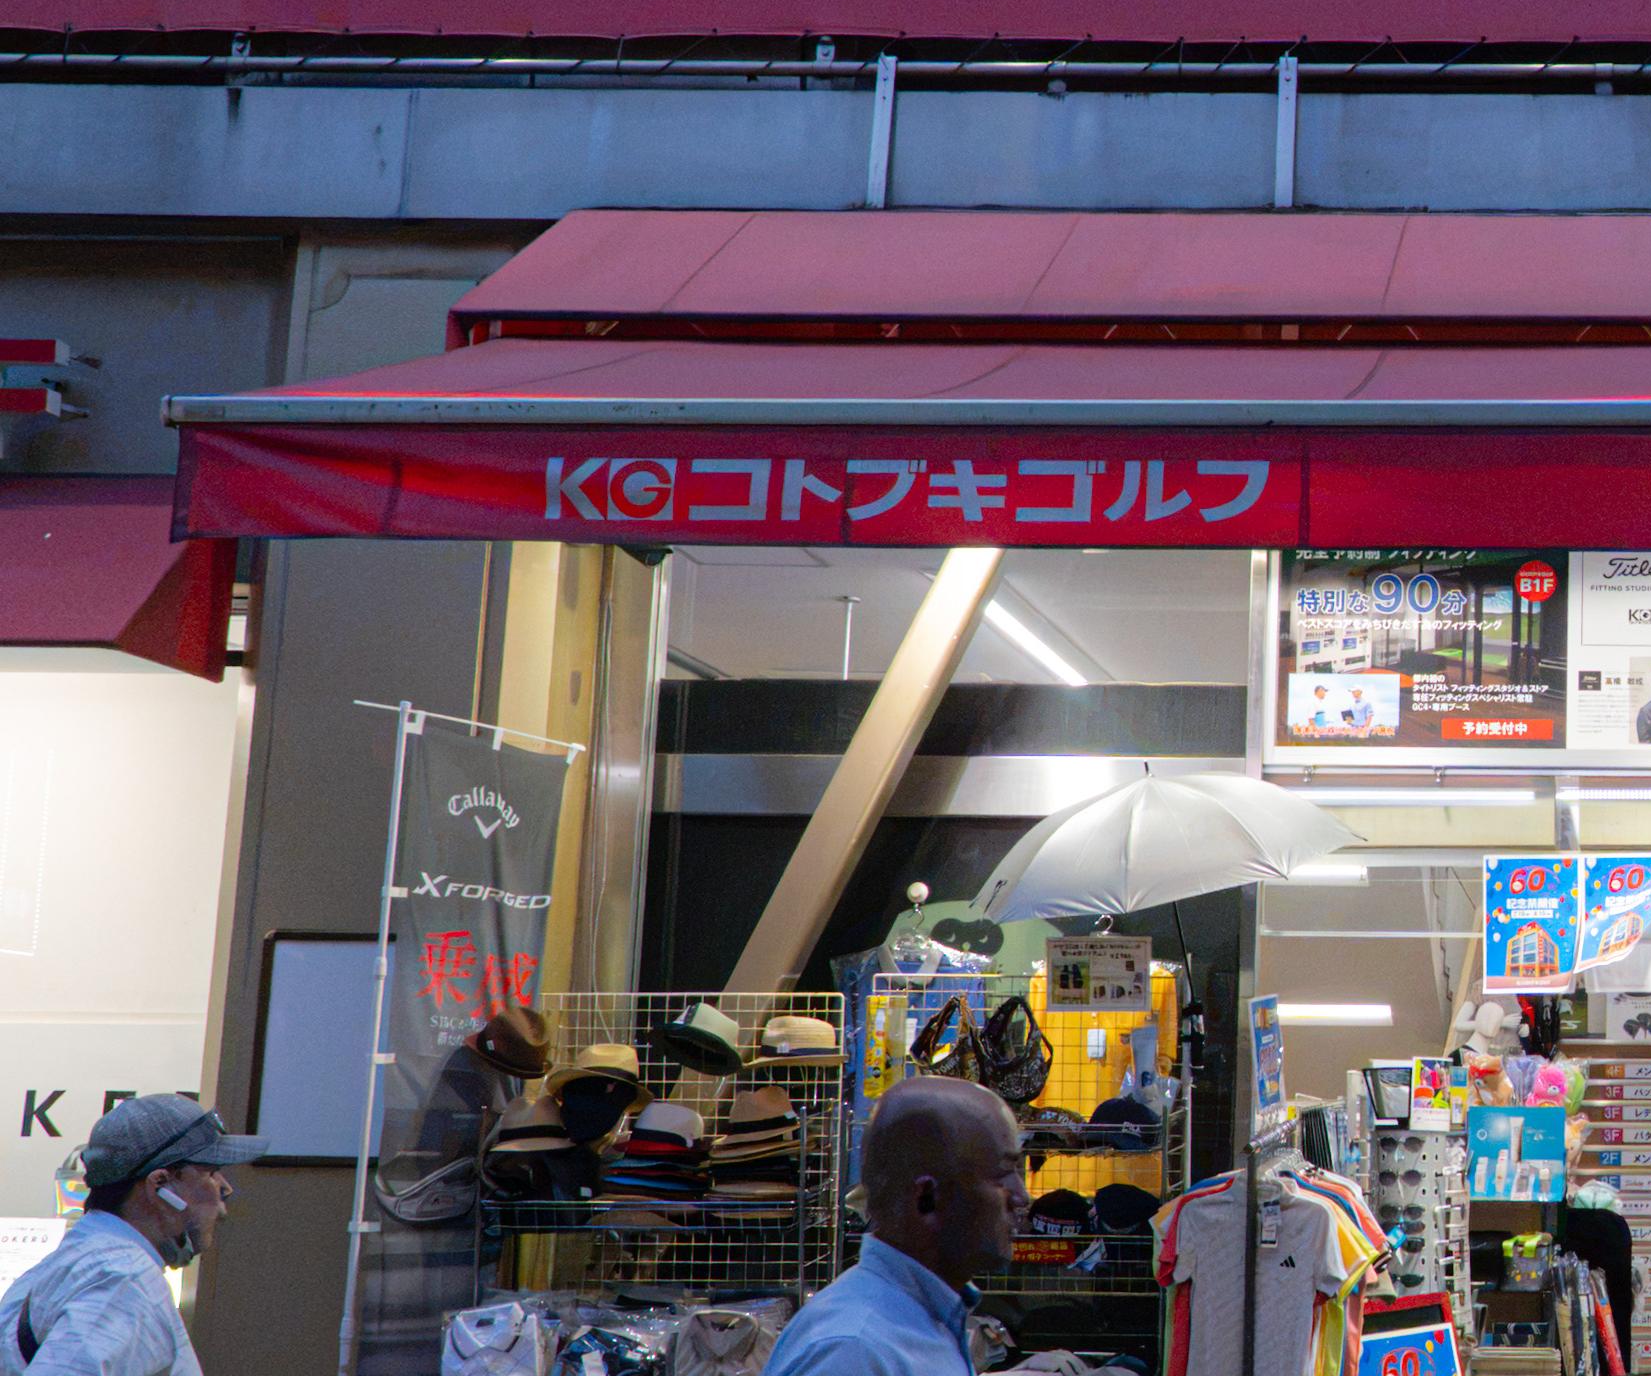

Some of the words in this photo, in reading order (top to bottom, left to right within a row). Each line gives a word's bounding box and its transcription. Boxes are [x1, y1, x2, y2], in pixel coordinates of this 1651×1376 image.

[545, 457, 1270, 522] KGコトブキゴルフ
[1520, 578, 1554, 592] B1F
[1297, 573, 1467, 615] 特別な90分
[1462, 722, 1528, 736] 予約受付中
[448, 786, 520, 829] Callaway
[1510, 867, 1547, 895] 60
[1608, 866, 1645, 893] 60
[1605, 1086, 1621, 1098] 3F
[1604, 1106, 1620, 1118] 3F
[1604, 1129, 1620, 1141] 3F
[1602, 1152, 1618, 1164] 2F
